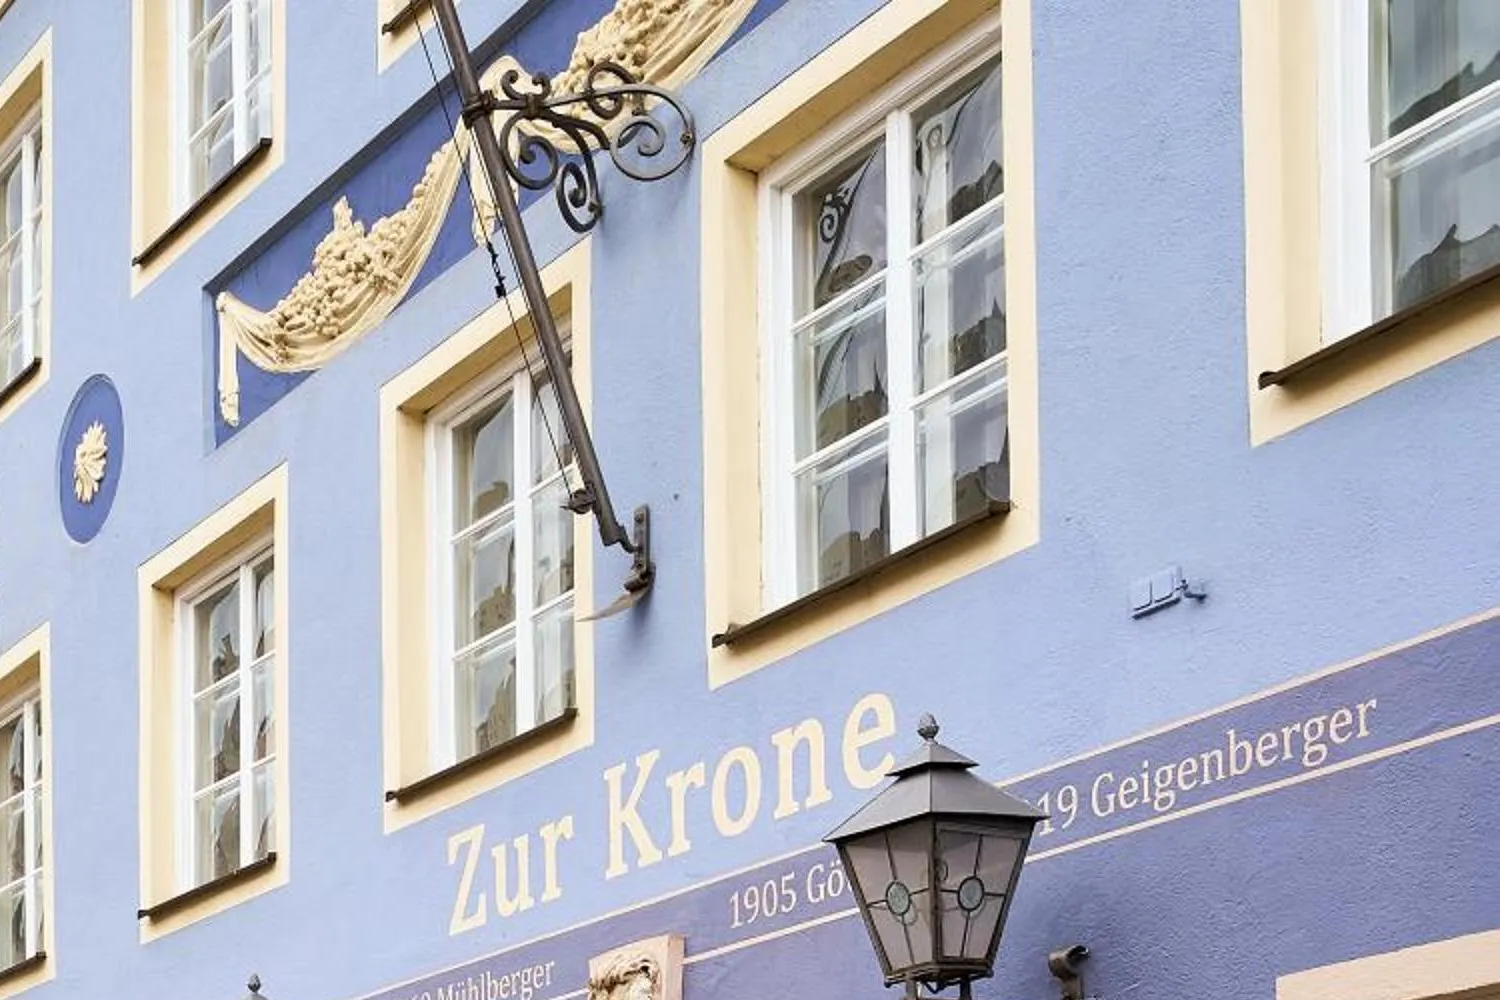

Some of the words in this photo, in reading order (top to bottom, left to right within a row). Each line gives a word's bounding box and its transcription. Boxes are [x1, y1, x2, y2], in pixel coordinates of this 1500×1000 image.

[447, 815, 575, 936] Zur
[603, 692, 897, 880] Krone
[1023, 784, 1078, 837] 19
[1091, 699, 1377, 818] Geigenberger
[729, 871, 797, 929] 1905
[806, 858, 853, 904] Gö
